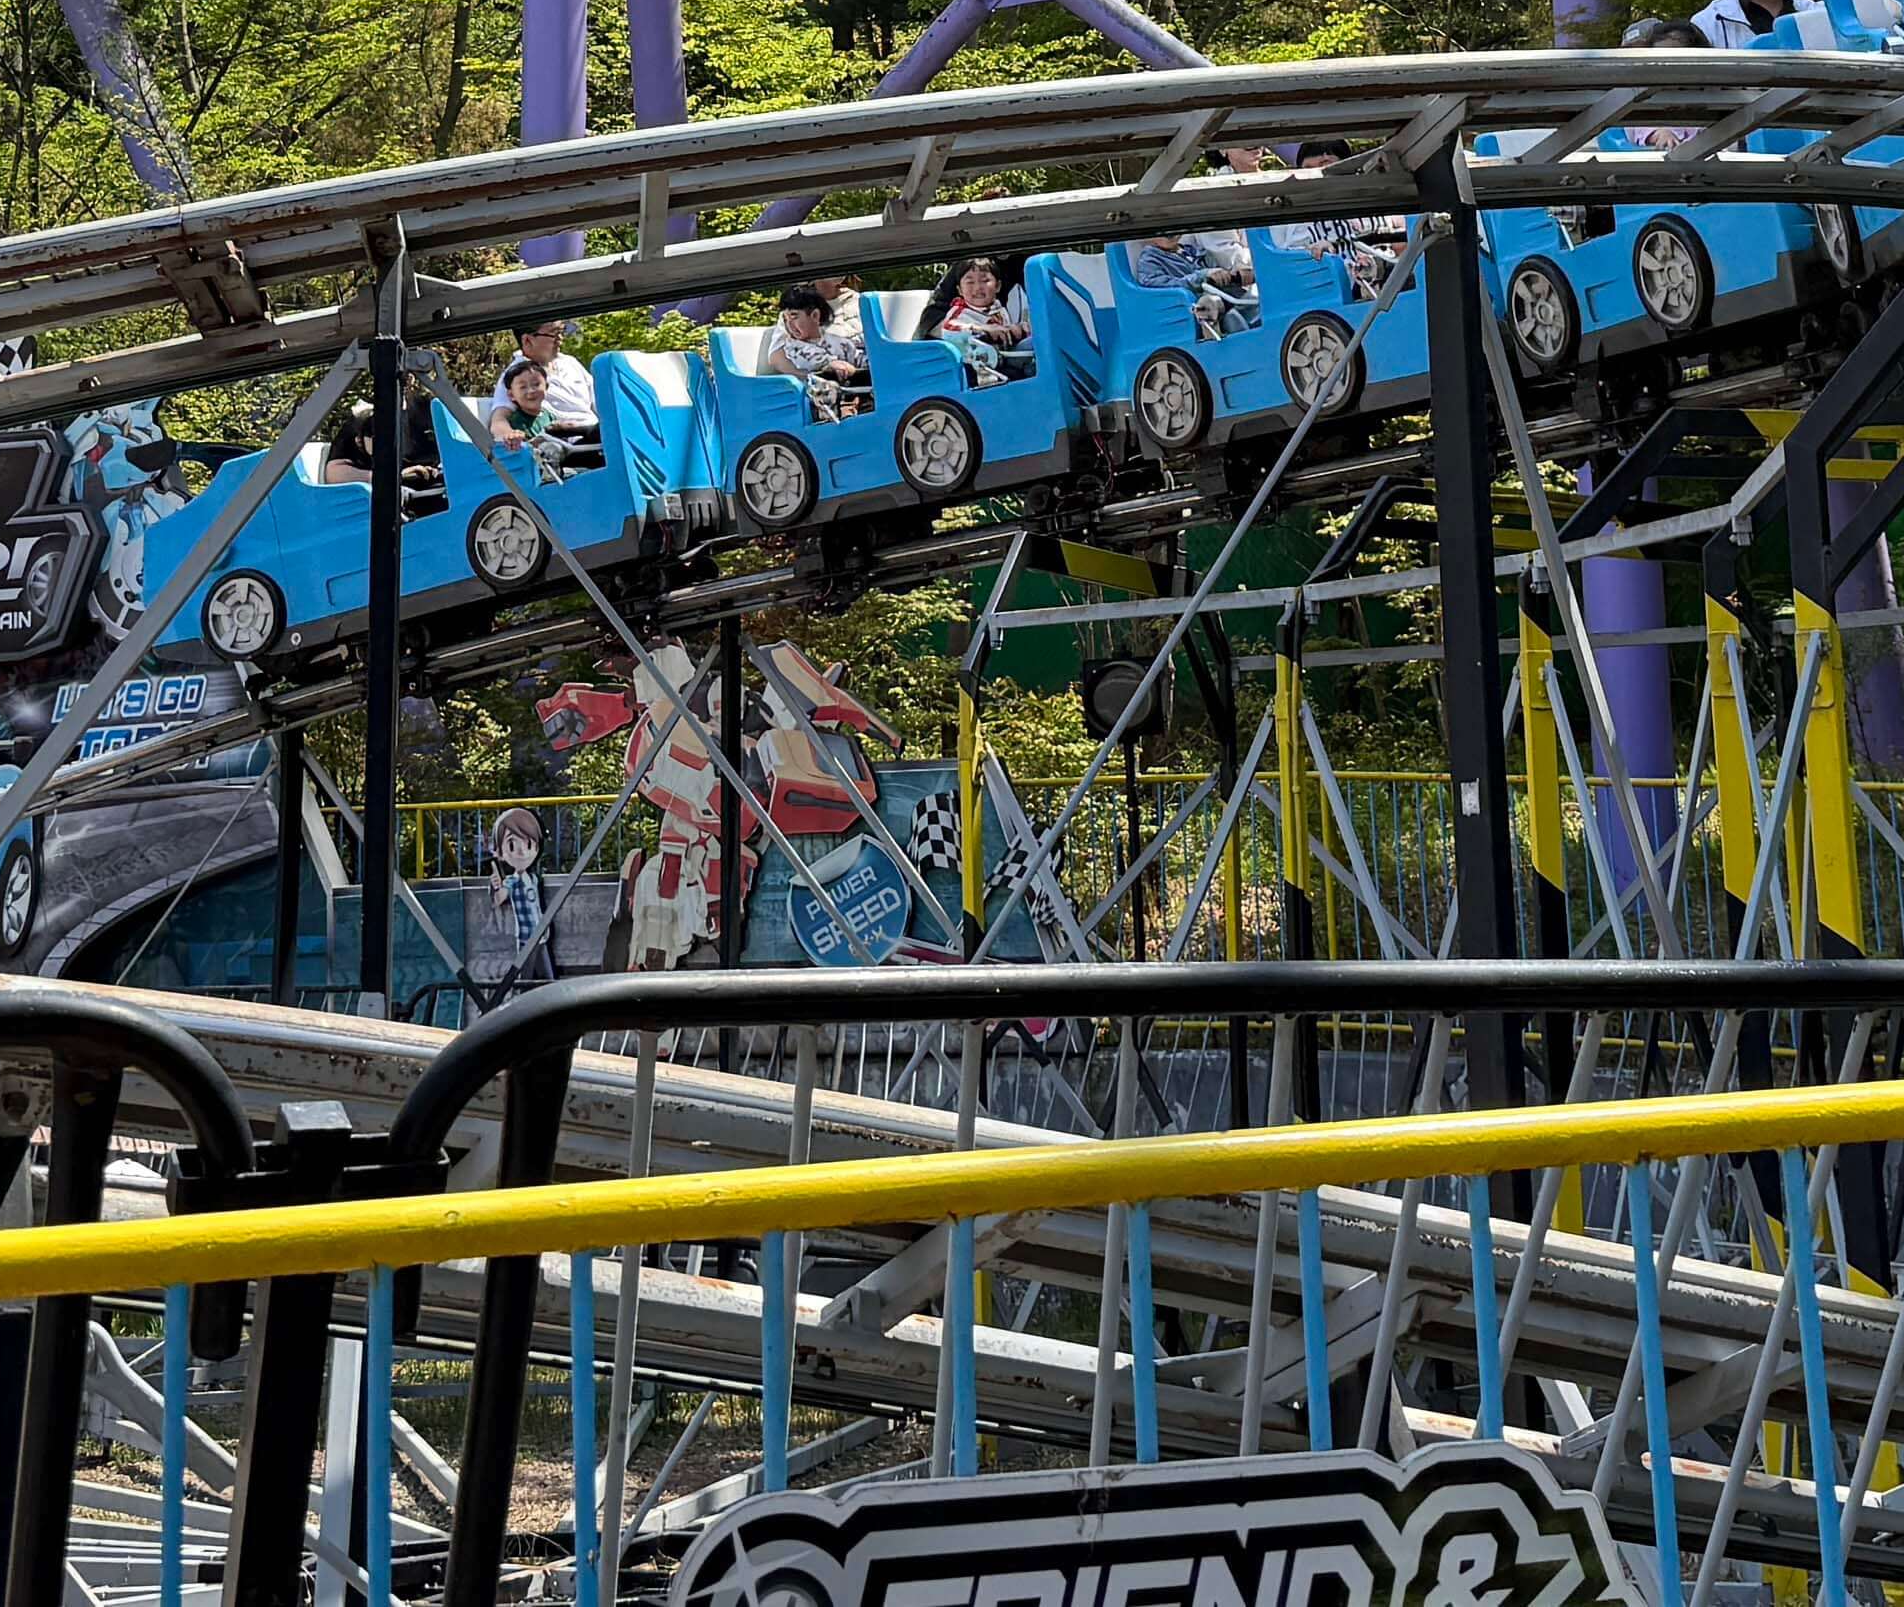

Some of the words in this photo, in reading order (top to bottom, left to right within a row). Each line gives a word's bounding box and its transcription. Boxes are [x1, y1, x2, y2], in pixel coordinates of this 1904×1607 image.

[51, 678, 152, 724] L'S
[155, 674, 209, 715] GO
[806, 866, 877, 921] PWER
